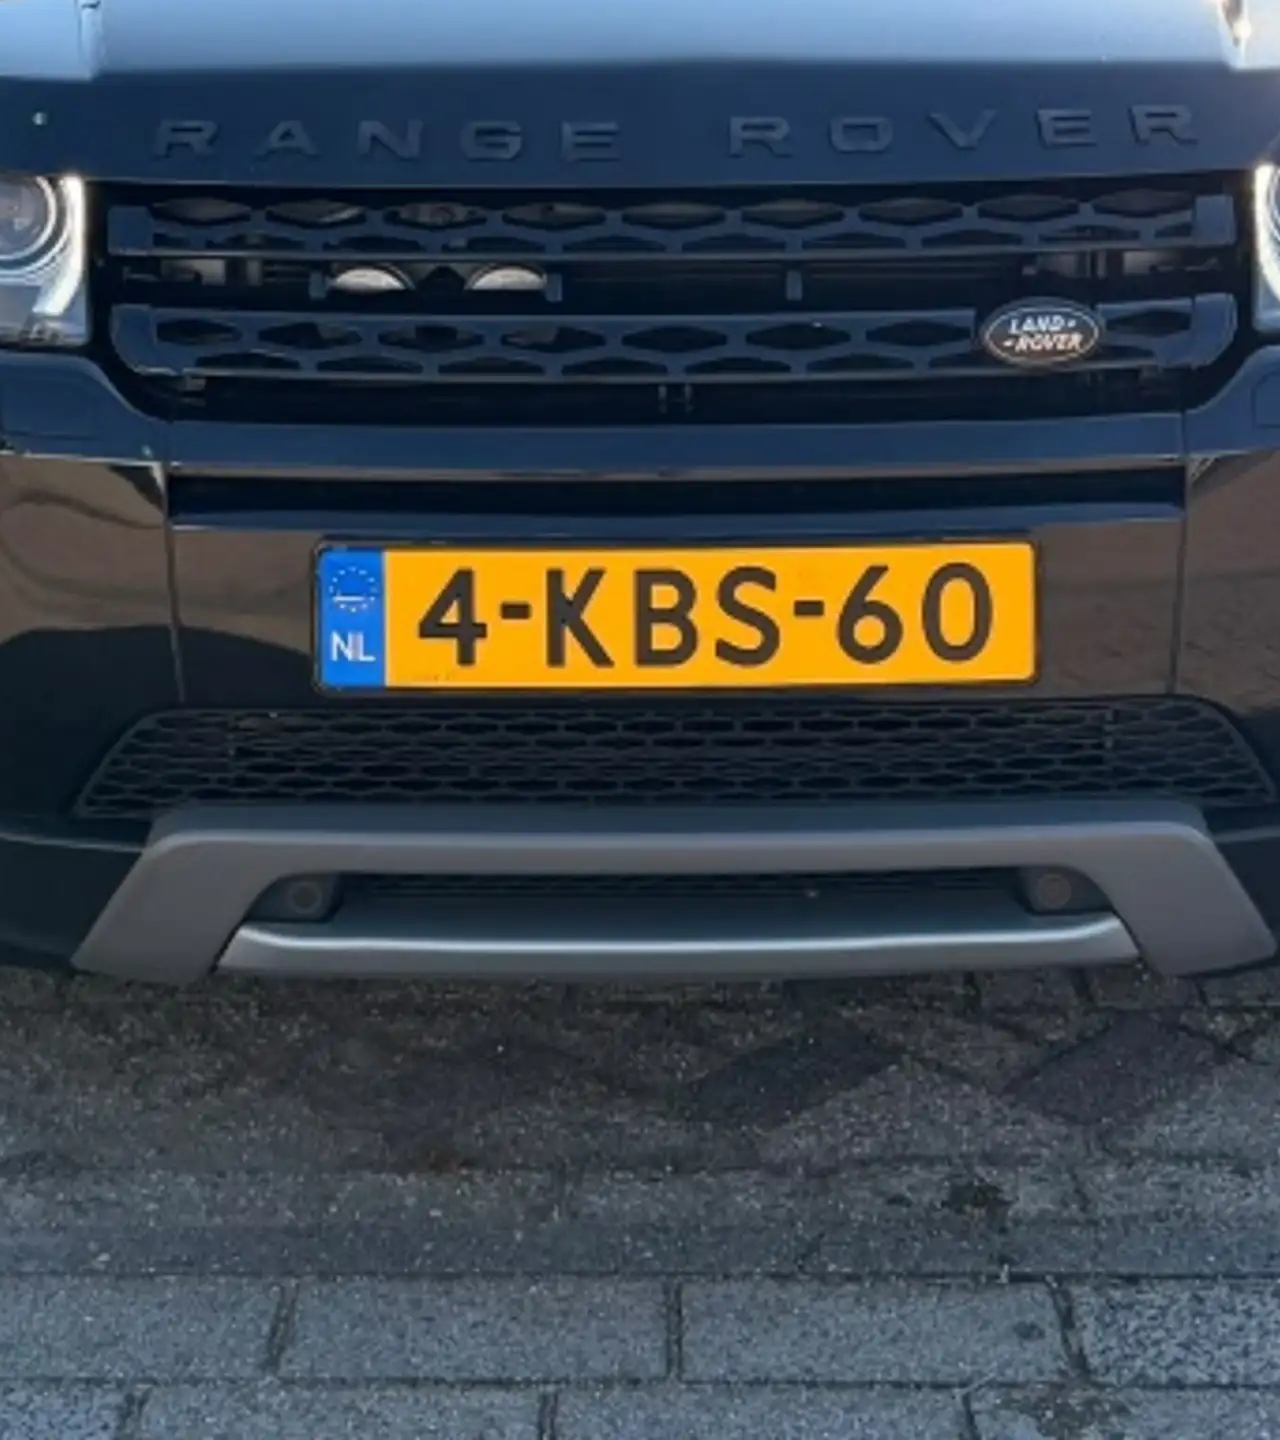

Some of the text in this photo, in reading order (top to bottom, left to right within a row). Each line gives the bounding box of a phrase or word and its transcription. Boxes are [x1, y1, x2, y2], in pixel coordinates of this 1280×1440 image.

[154, 102, 1199, 160] RANGE ROVER
[1009, 314, 1065, 335] LAND
[418, 562, 994, 668] 4-KBS-60
[331, 630, 377, 662] NL
